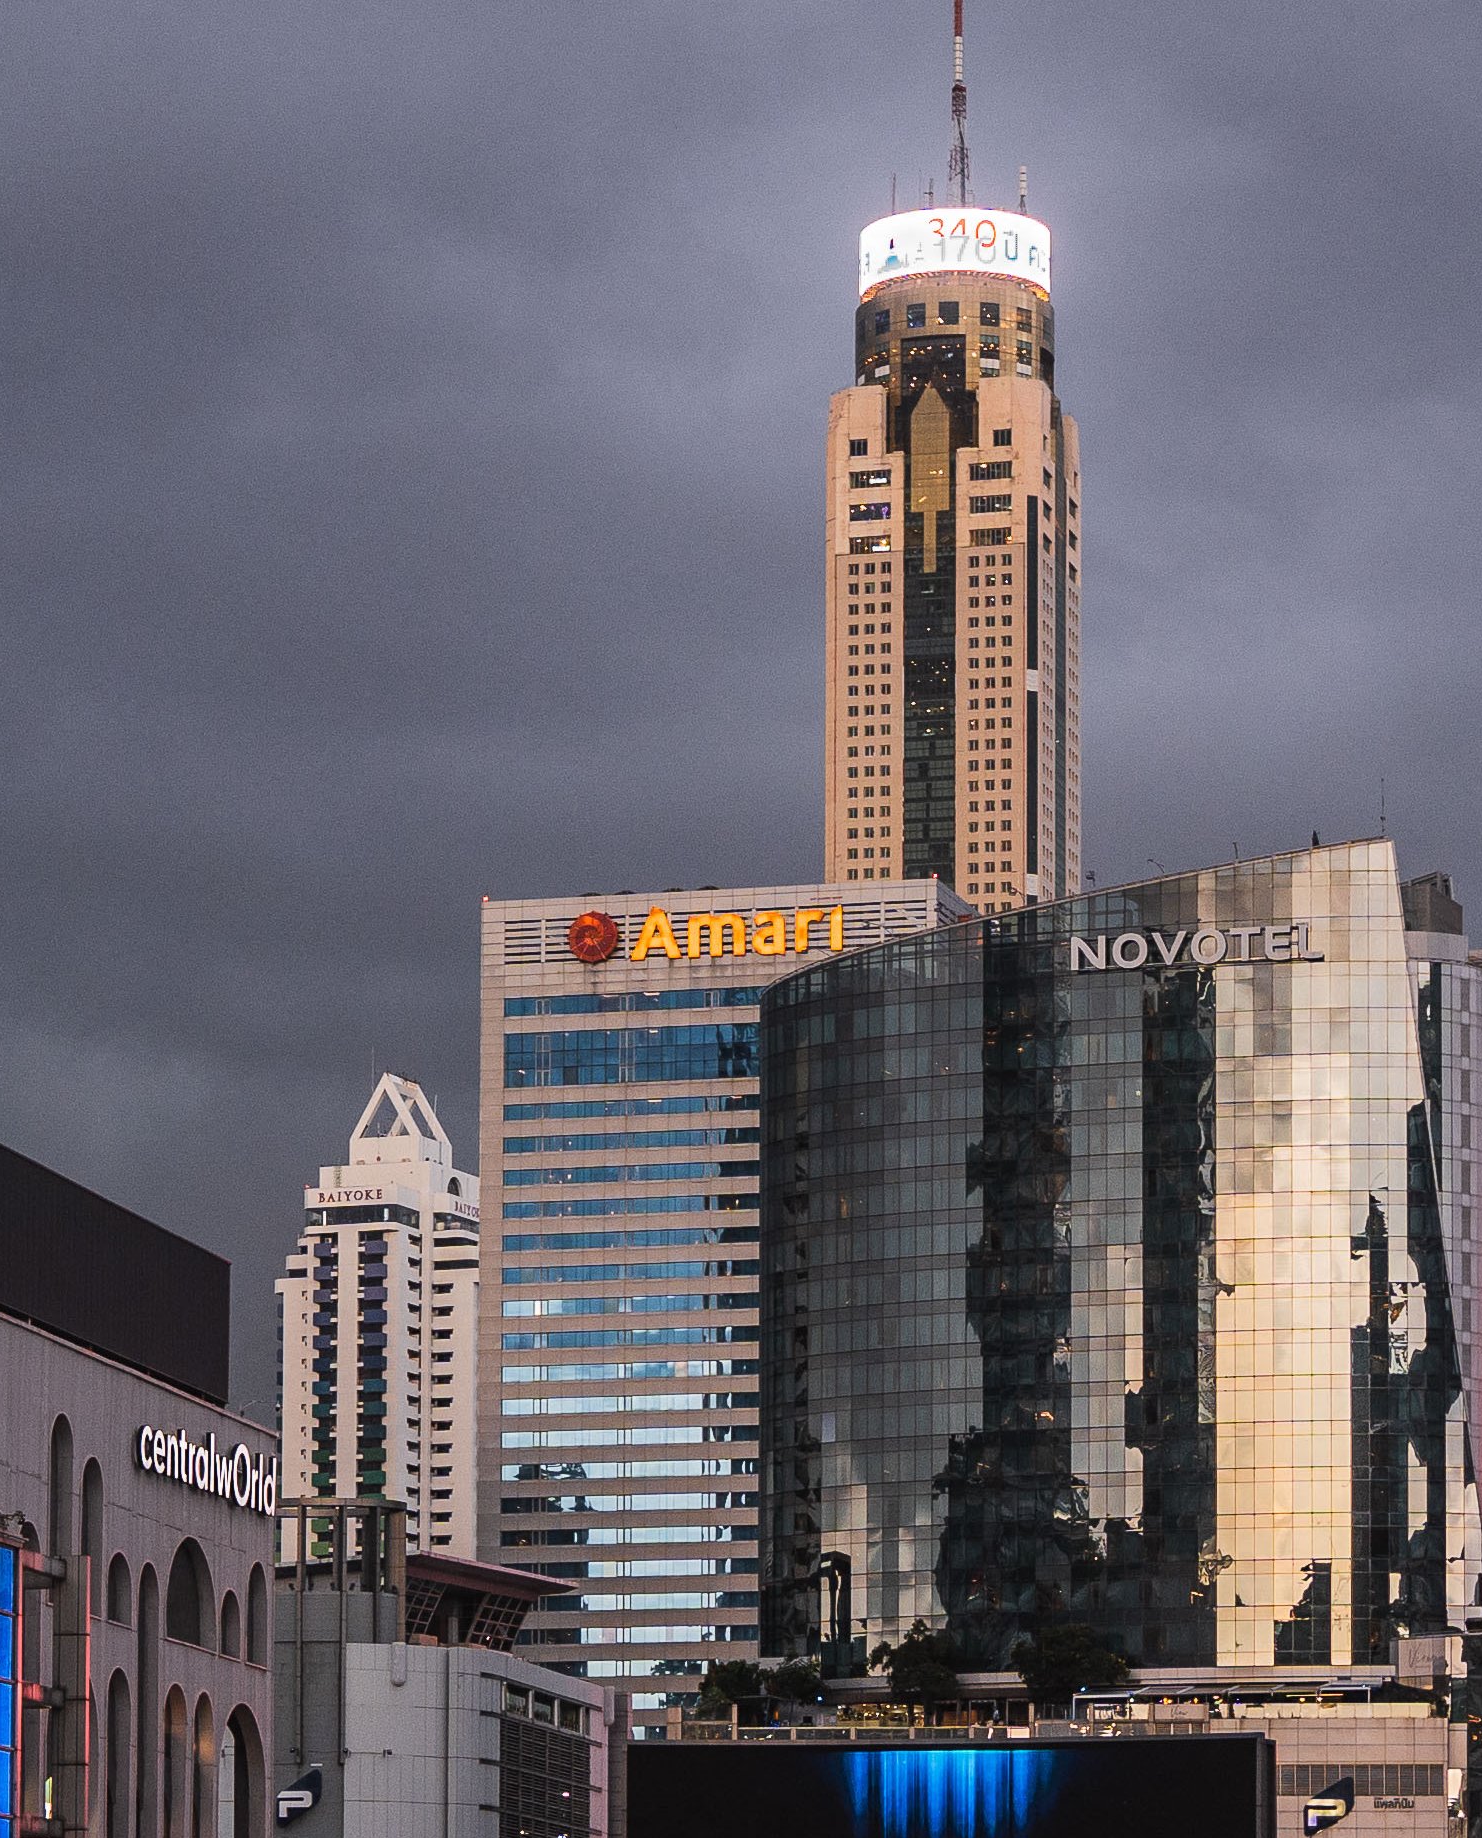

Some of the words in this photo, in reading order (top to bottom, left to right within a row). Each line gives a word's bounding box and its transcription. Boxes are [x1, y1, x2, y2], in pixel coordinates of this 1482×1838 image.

[631, 905, 844, 962] Amari
[1069, 923, 1324, 971] NOVOTEL
[318, 1188, 383, 1204] BAIYOKE
